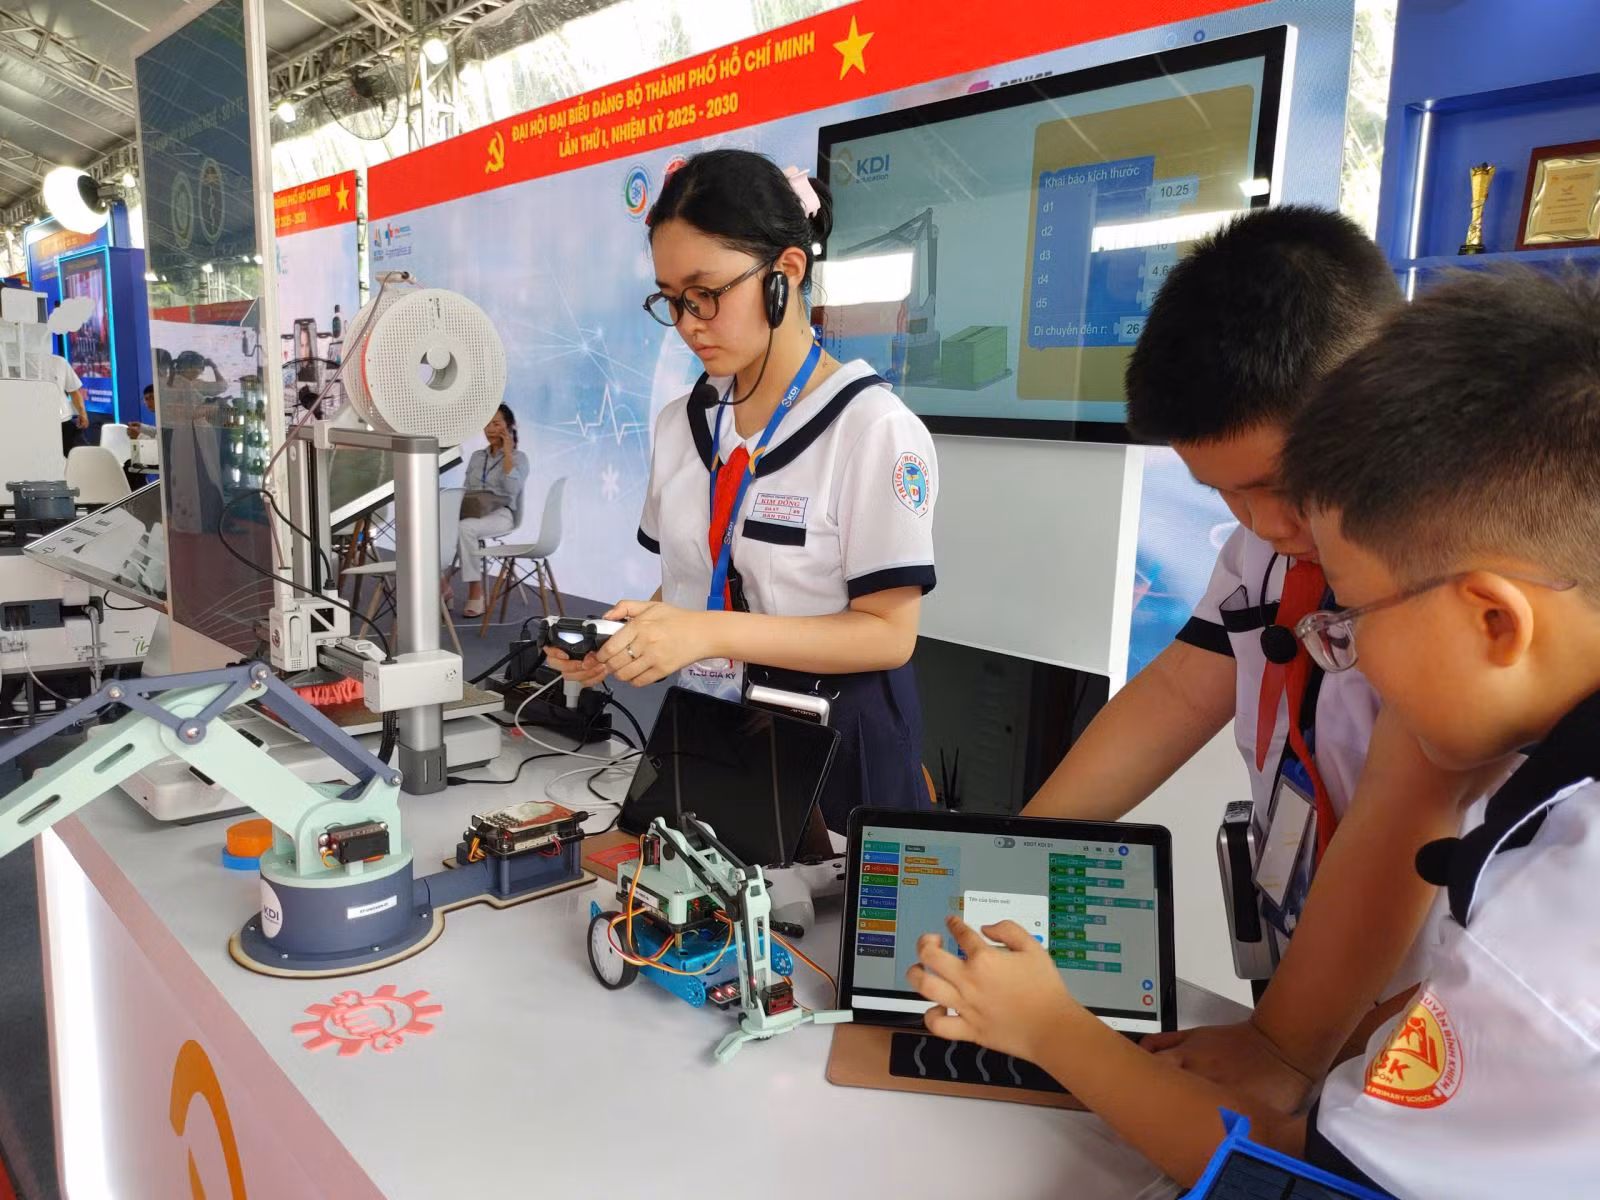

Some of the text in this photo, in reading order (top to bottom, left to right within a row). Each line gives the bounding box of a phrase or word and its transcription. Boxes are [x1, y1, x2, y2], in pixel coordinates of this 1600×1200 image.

[512, 31, 815, 144] ĐẠI HỘI ĐẠI BIỂU ĐẢNG BỘ THÀNH PHỐ HỒ CHÍ MINH
[559, 131, 579, 158] LẦN
[581, 126, 600, 152] THỨ
[611, 116, 646, 144] NHIỆM
[649, 108, 664, 134] KỲ
[666, 103, 696, 130] 2025
[706, 92, 739, 119] 2030
[857, 154, 890, 176] KDI
[1044, 177, 1065, 188] Khai
[1110, 165, 1140, 179] thước
[1043, 184, 1190, 213] d1 10.25
[1041, 226, 1053, 237] d2
[1039, 250, 1051, 261] d3
[1037, 265, 1174, 285] d4 4.6
[1036, 297, 1048, 309] d5
[1034, 326, 1044, 336] Di
[1045, 322, 1078, 338] chuyển
[1080, 322, 1098, 335] đến
[787, 385, 799, 400] KDI
[777, 499, 801, 507] ĐỒNG
[264, 904, 279, 921] KDI
